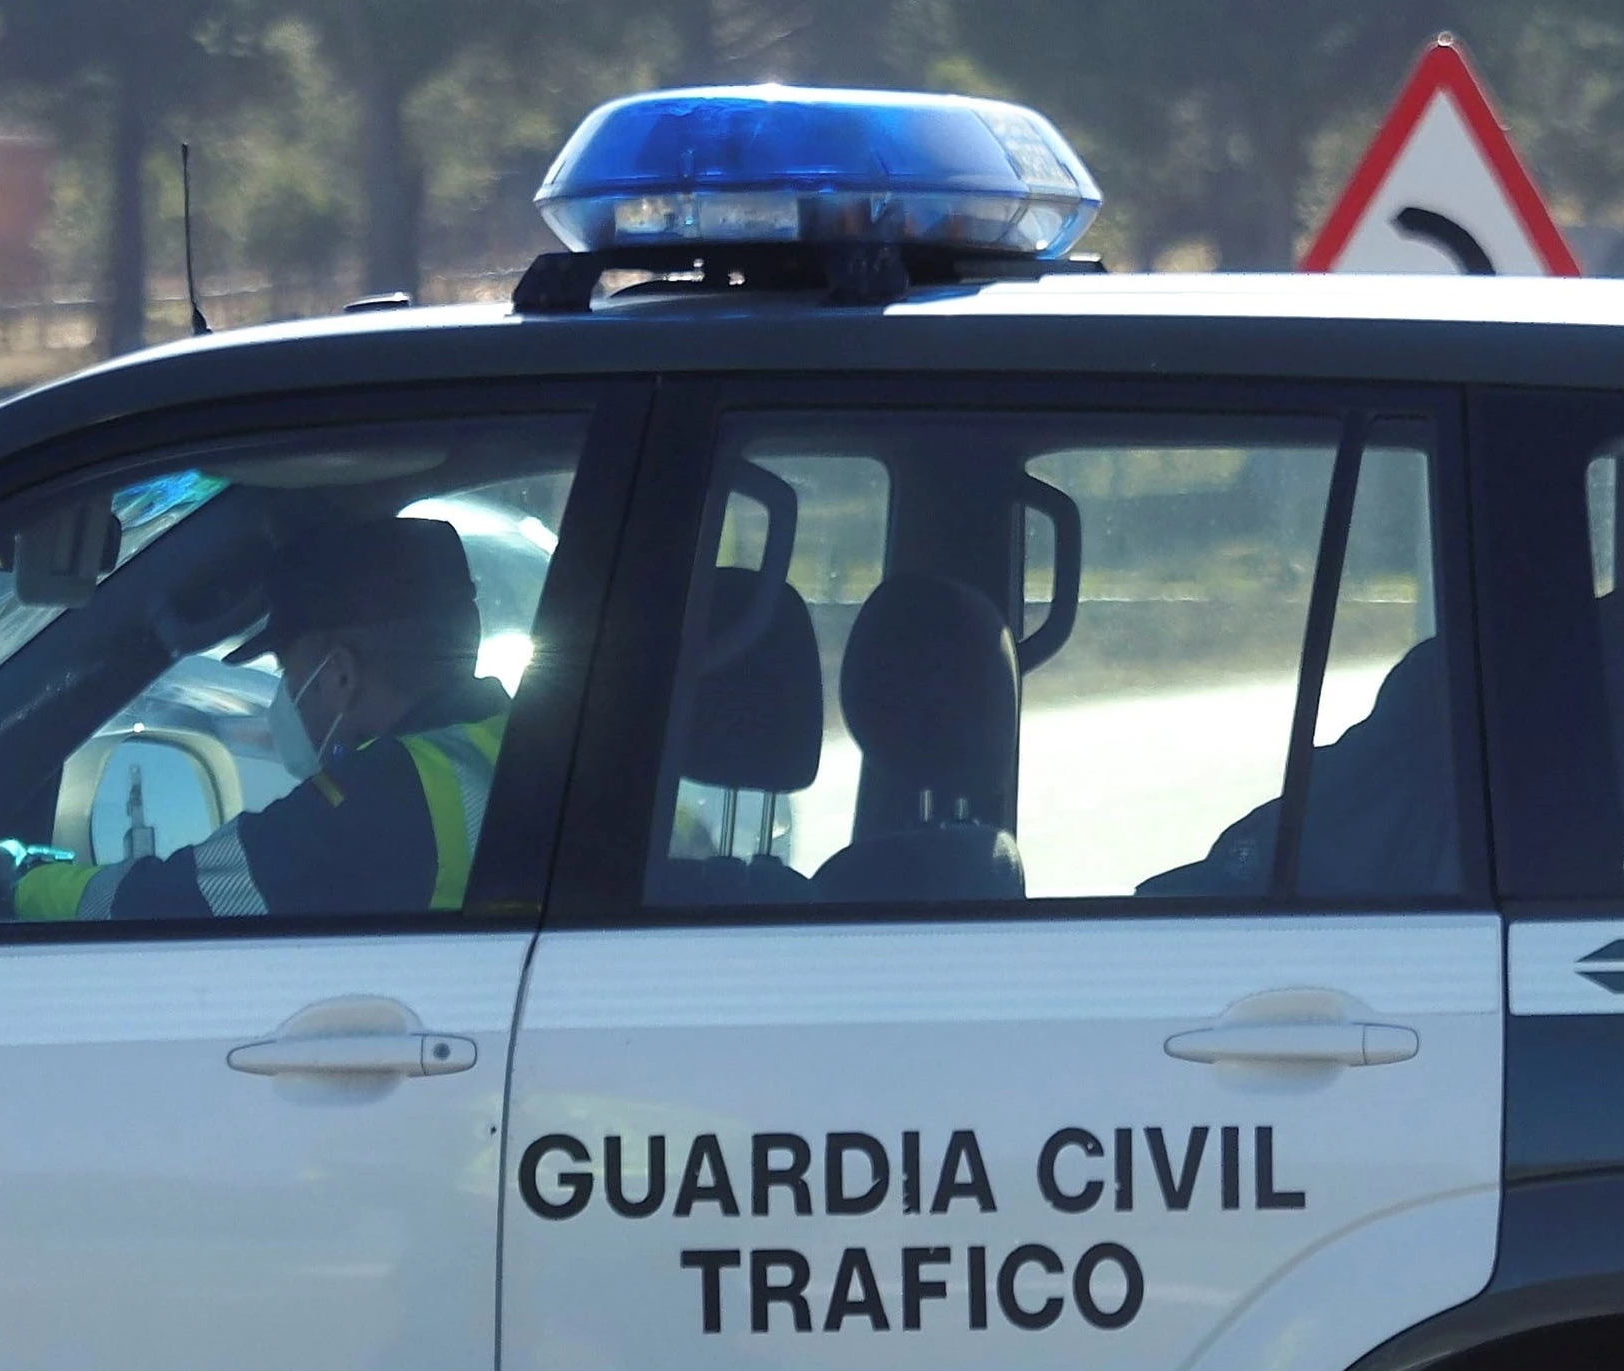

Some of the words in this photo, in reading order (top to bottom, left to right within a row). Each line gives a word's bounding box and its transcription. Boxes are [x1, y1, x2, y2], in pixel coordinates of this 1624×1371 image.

[518, 1130, 998, 1220] GUARDIA
[1037, 1126, 1306, 1213] CIVIL
[681, 1242, 1145, 1334] TRAFICO
